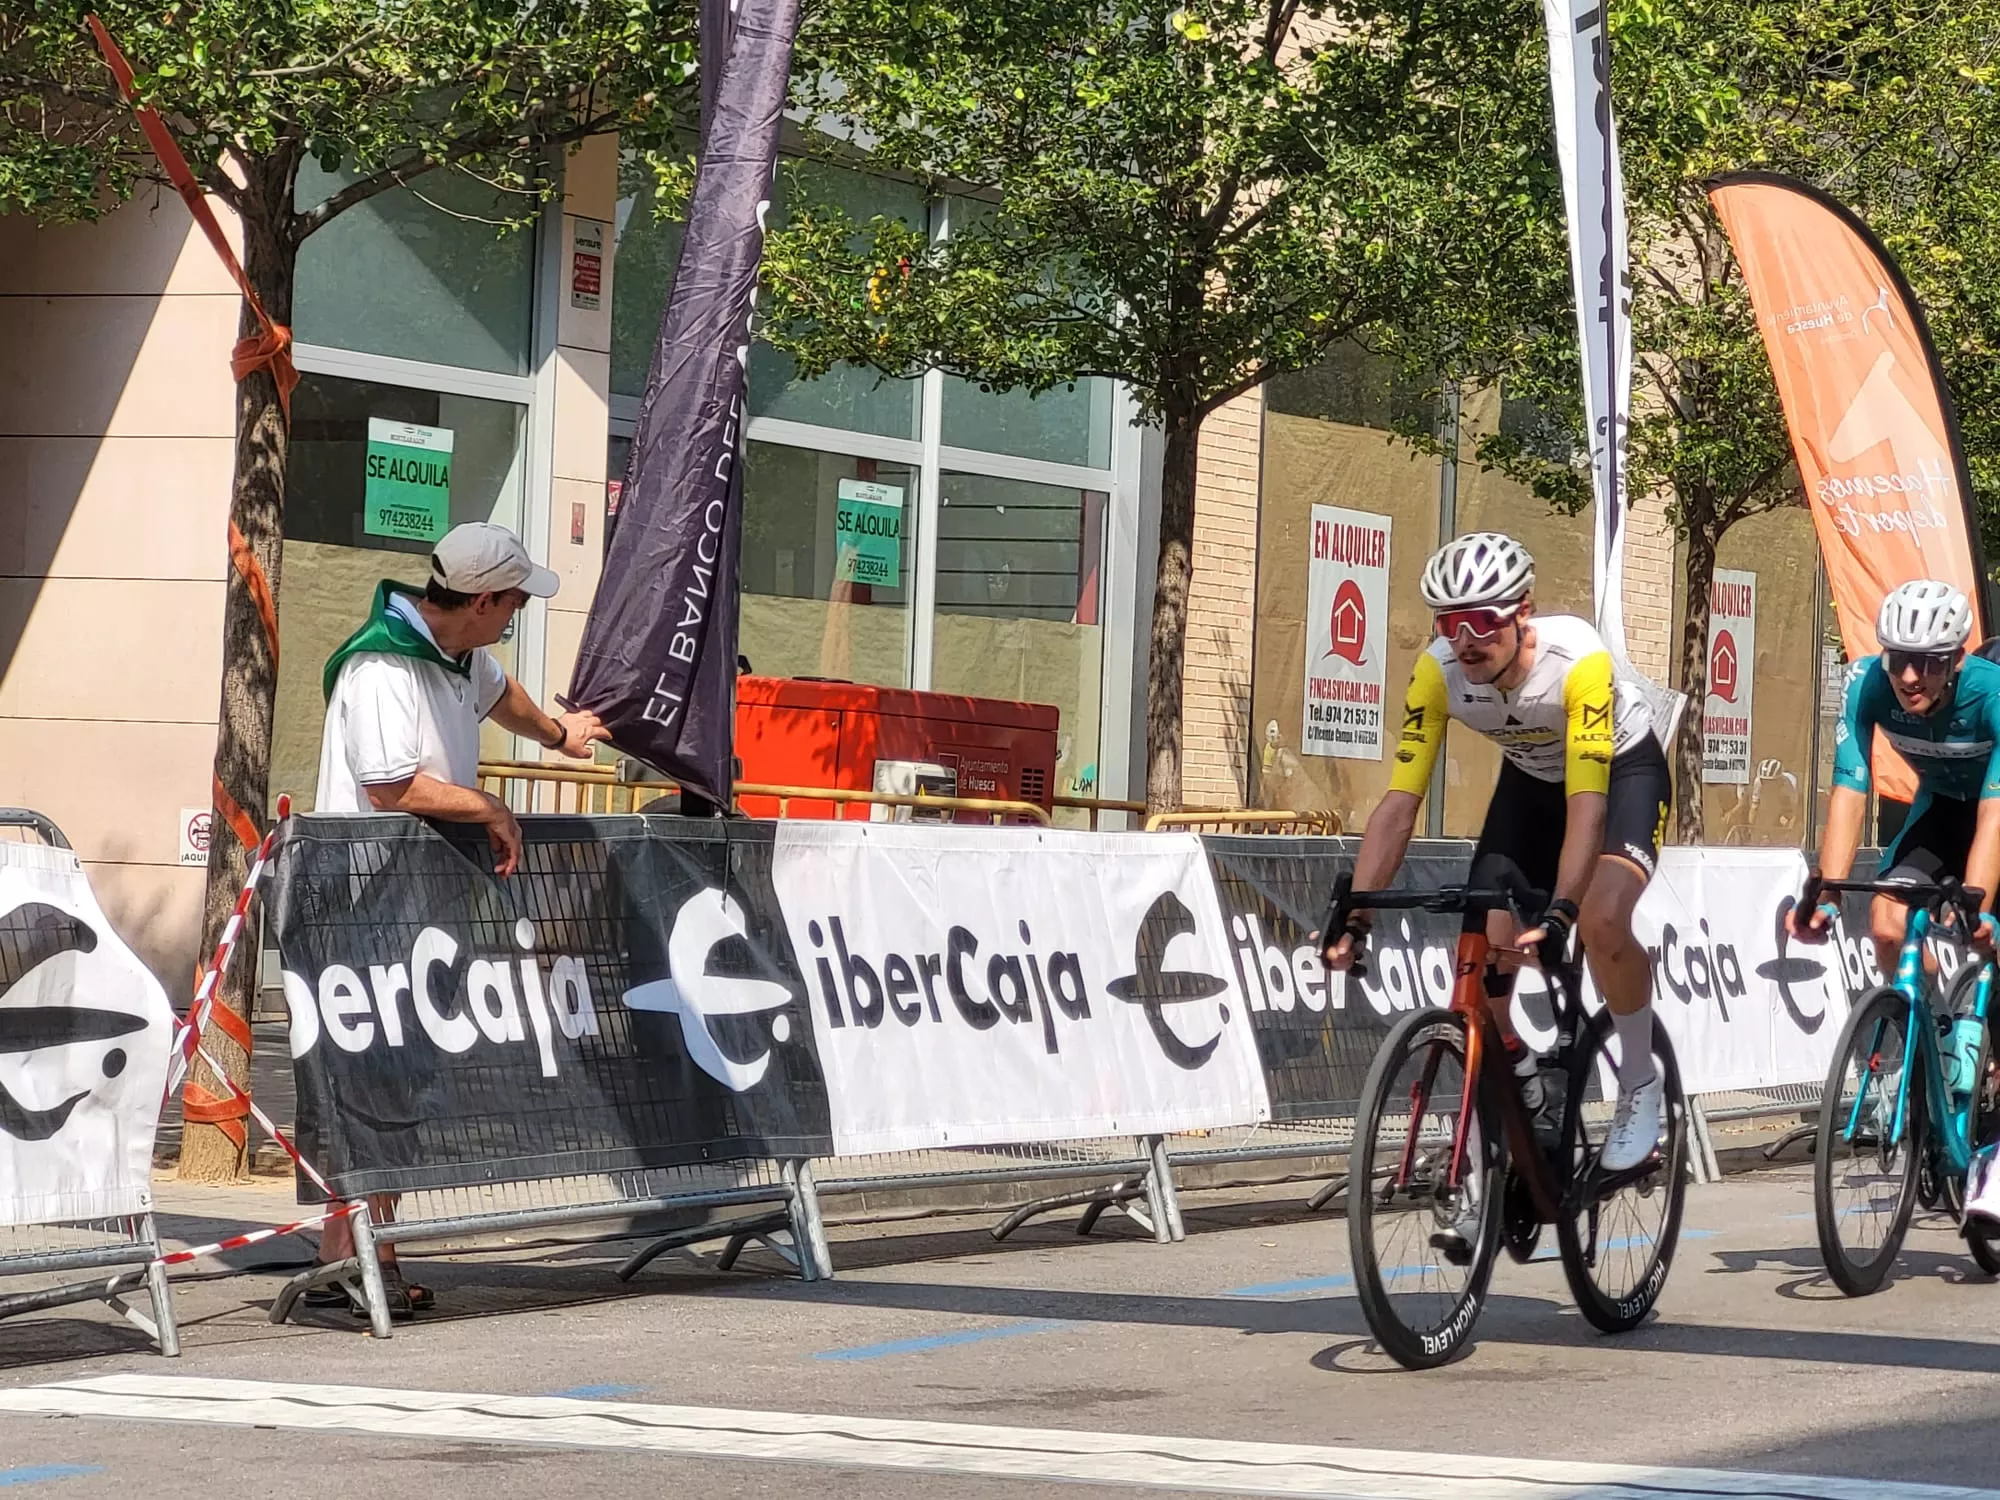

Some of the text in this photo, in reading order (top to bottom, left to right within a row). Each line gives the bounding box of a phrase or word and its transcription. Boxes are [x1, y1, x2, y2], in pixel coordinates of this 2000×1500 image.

[367, 454, 449, 489] SE ALQUILA
[379, 508, 434, 532] 974238244
[837, 510, 900, 538] SE ALQUILA
[1314, 519, 1385, 569] EN ALQUILER
[1711, 581, 1752, 619] ALQUILER
[1309, 677, 1380, 705] FINCASVICAM.COM
[1309, 704, 1379, 727] Tel. 974 21 53 31
[959, 757, 1009, 774] Ayuntamiento
[968, 775, 996, 792] Huesca
[808, 915, 1091, 1055] iberCaja
[1617, 1292, 1646, 1320] LEVEL
[1420, 1292, 1477, 1355] HIGH LEVEL
